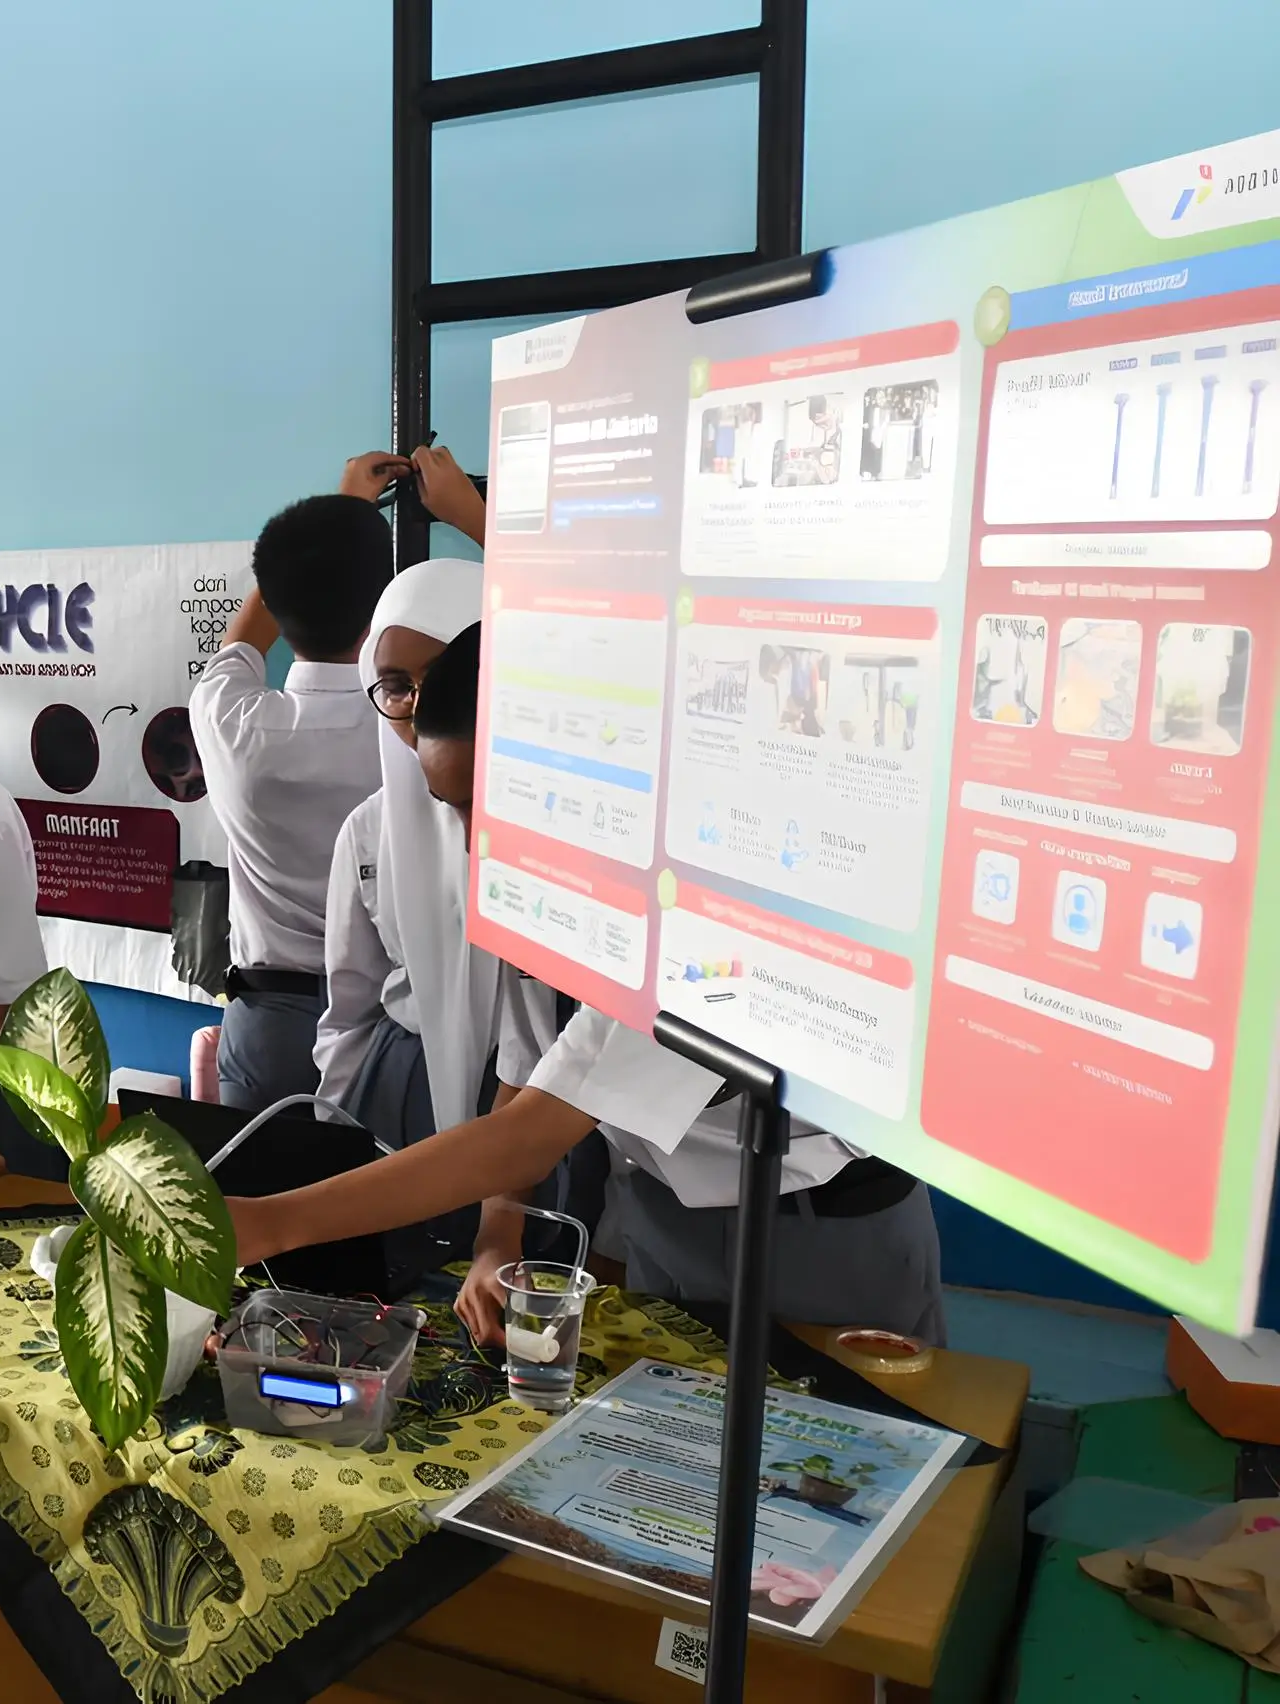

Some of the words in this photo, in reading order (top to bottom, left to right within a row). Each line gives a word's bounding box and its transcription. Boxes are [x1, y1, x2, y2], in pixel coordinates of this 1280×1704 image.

[194, 573, 226, 592] dari
[180, 598, 243, 618] ampas
[191, 615, 227, 642] kopi
[46, 813, 120, 838] MANFAAT
